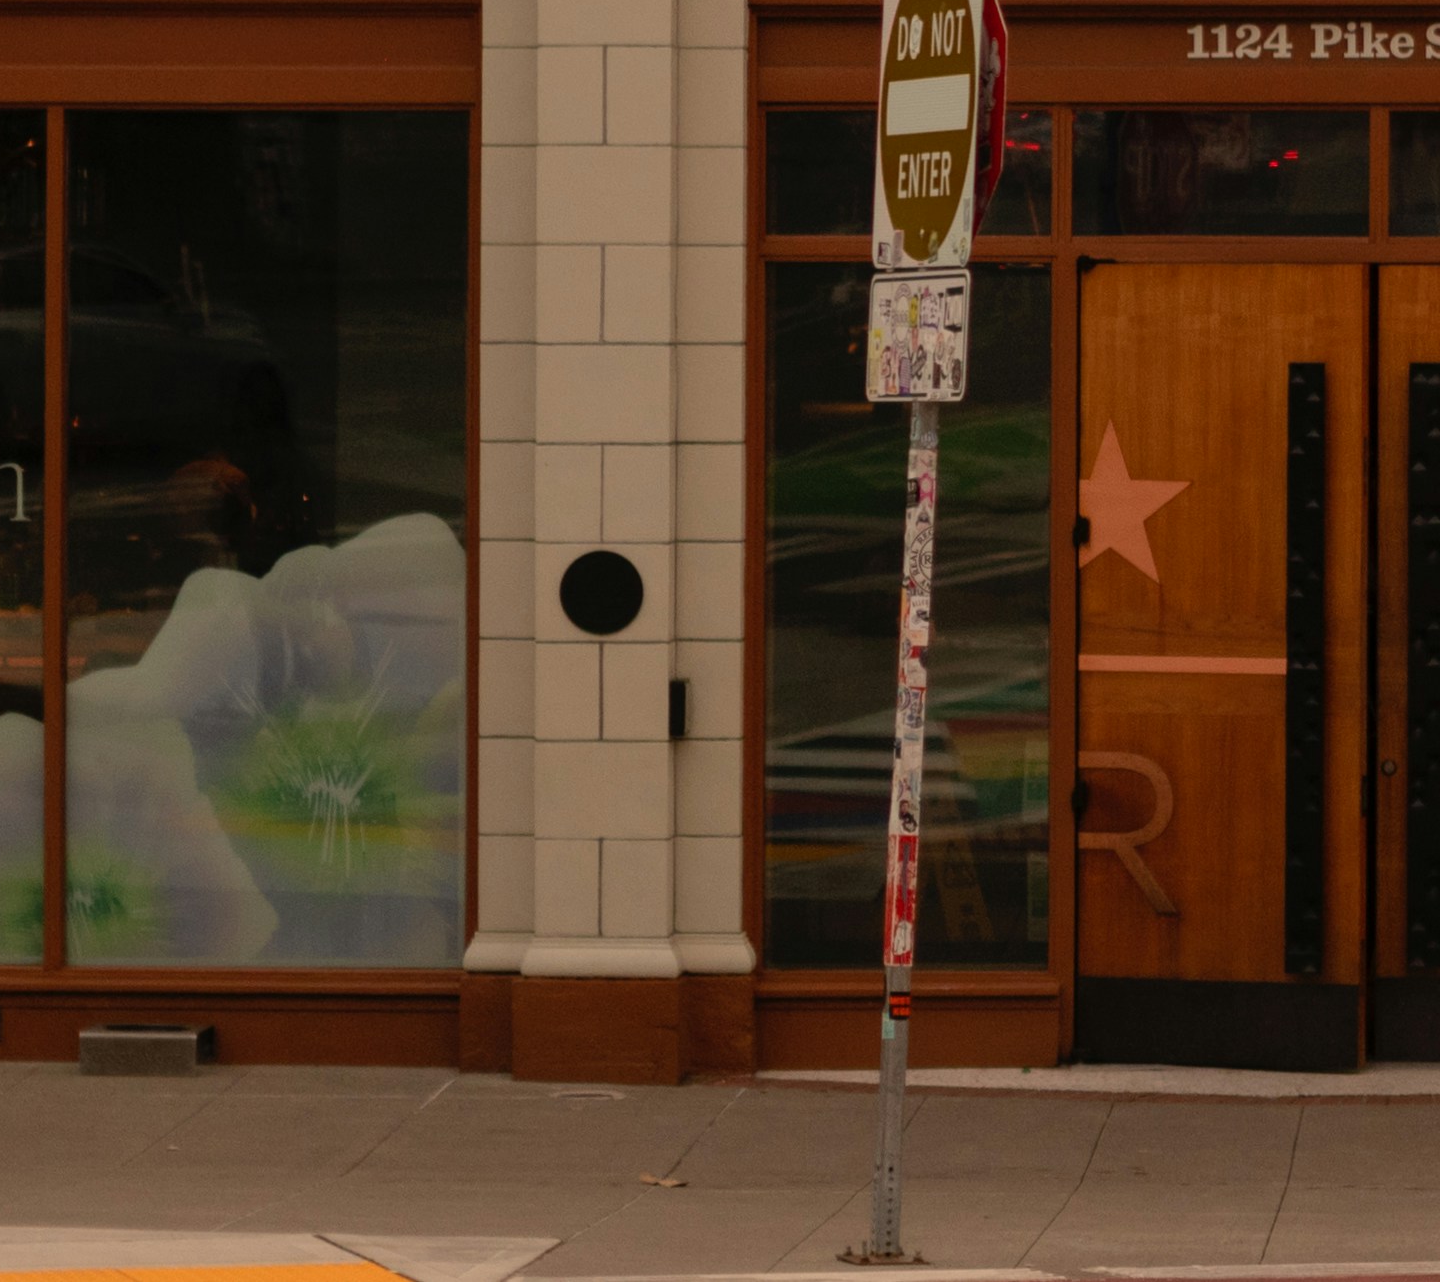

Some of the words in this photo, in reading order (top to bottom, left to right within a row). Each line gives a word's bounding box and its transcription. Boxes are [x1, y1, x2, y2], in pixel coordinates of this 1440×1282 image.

[930, 8, 966, 58] NOT
[1187, 24, 1293, 60] 1124
[1310, 22, 1415, 60] Pike
[896, 151, 952, 199] ENTER
